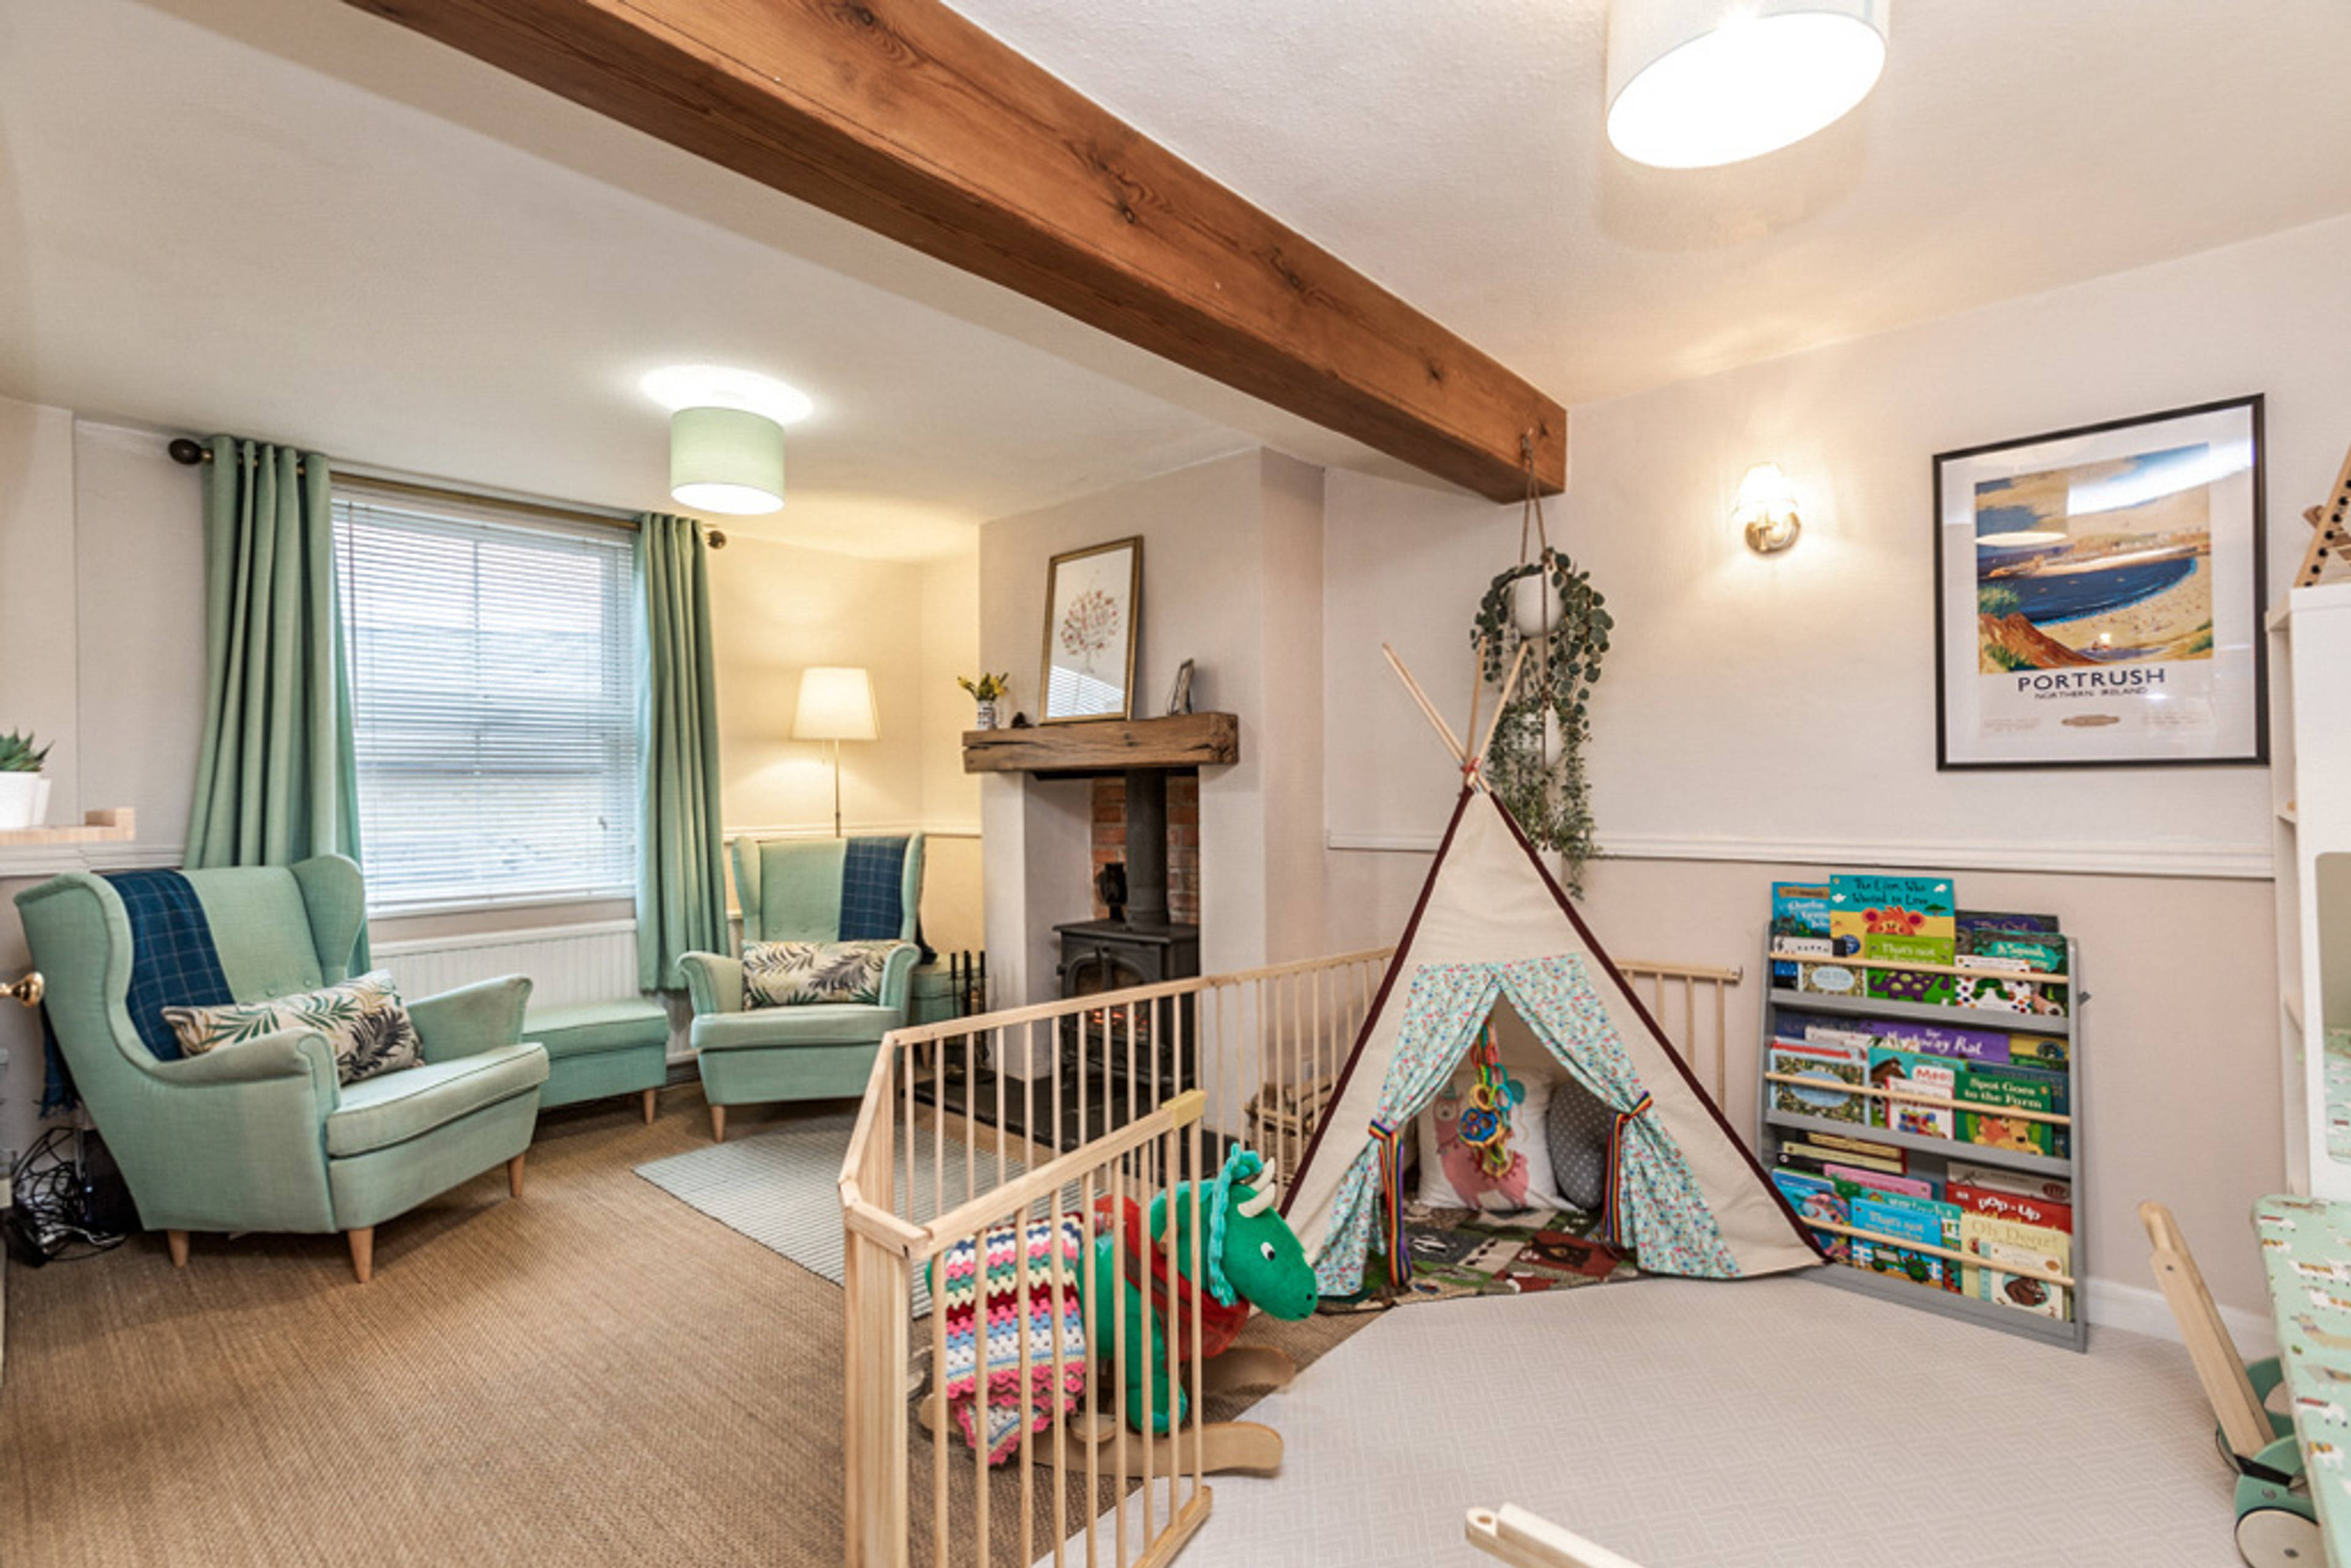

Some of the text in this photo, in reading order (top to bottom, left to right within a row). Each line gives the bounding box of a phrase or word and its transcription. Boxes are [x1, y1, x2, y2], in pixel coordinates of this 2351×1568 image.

[2018, 668, 2165, 692] PORTRUSH
[2034, 686, 2148, 699] NORTHERN IRELAND
[1954, 1036, 1983, 1055] Rat
[1970, 1077, 1999, 1091] Spot
[2002, 1080, 2036, 1096] Goes
[1964, 1089, 2042, 1109] to the Farm
